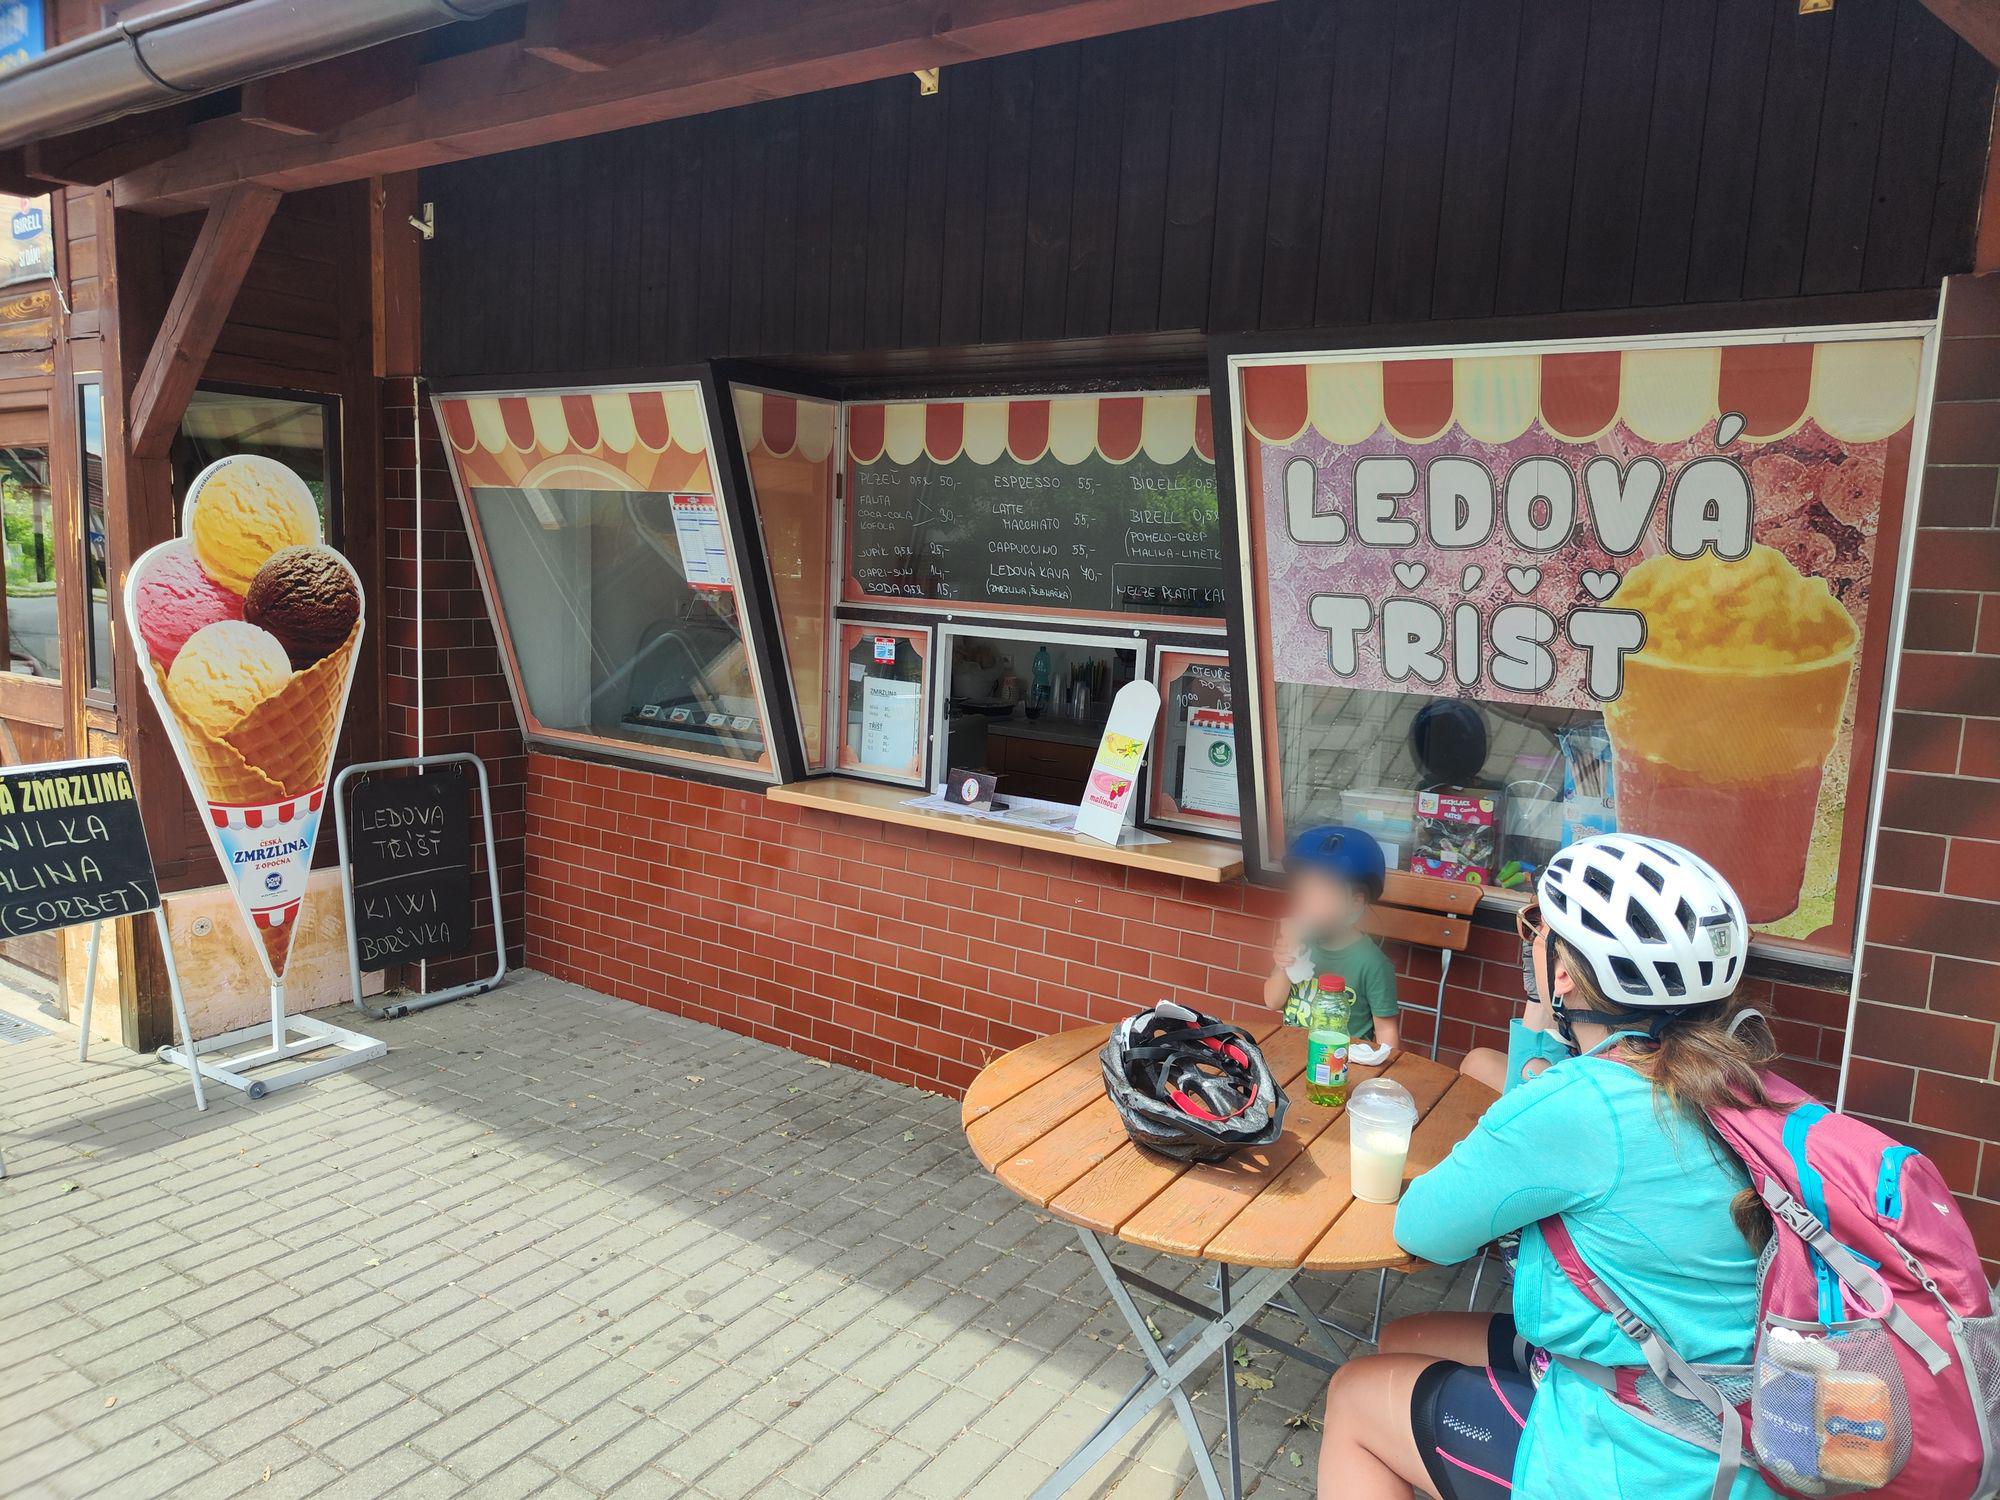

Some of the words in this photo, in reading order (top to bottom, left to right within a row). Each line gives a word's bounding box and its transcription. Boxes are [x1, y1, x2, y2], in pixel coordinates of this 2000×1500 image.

[13, 213, 42, 235] BIRELL
[939, 475, 962, 491] 50,-
[994, 475, 1060, 490] ESPRESSO
[1078, 476, 1101, 495] 55,-
[1130, 476, 1187, 491] BIRELL
[1282, 410, 1755, 562] LEDOVÁ
[857, 509, 914, 521] COCA-COLA
[939, 507, 964, 525] 30,-
[992, 503, 1024, 515] LATTE
[1129, 508, 1183, 524] BIRELL
[860, 521, 896, 531] KOFOLA
[1003, 517, 1060, 531] MACCHIATO
[1072, 512, 1097, 529] 55,-
[988, 540, 1058, 556] CAPPUCCINO
[1071, 543, 1096, 559] 55,-
[990, 561, 1036, 579] LEDOVÁ
[1039, 560, 1071, 580] KÁVA
[866, 581, 901, 596] SODA
[1116, 584, 1157, 598] NELZE
[1161, 585, 1199, 600] PLATIT
[1307, 561, 1649, 703] TŘÍŠŤ
[18, 770, 133, 813] ZMRZLINA
[234, 838, 309, 864] ZMRZLINA
[1, 880, 149, 936] (SORBET)
[363, 888, 437, 919] KIWI
